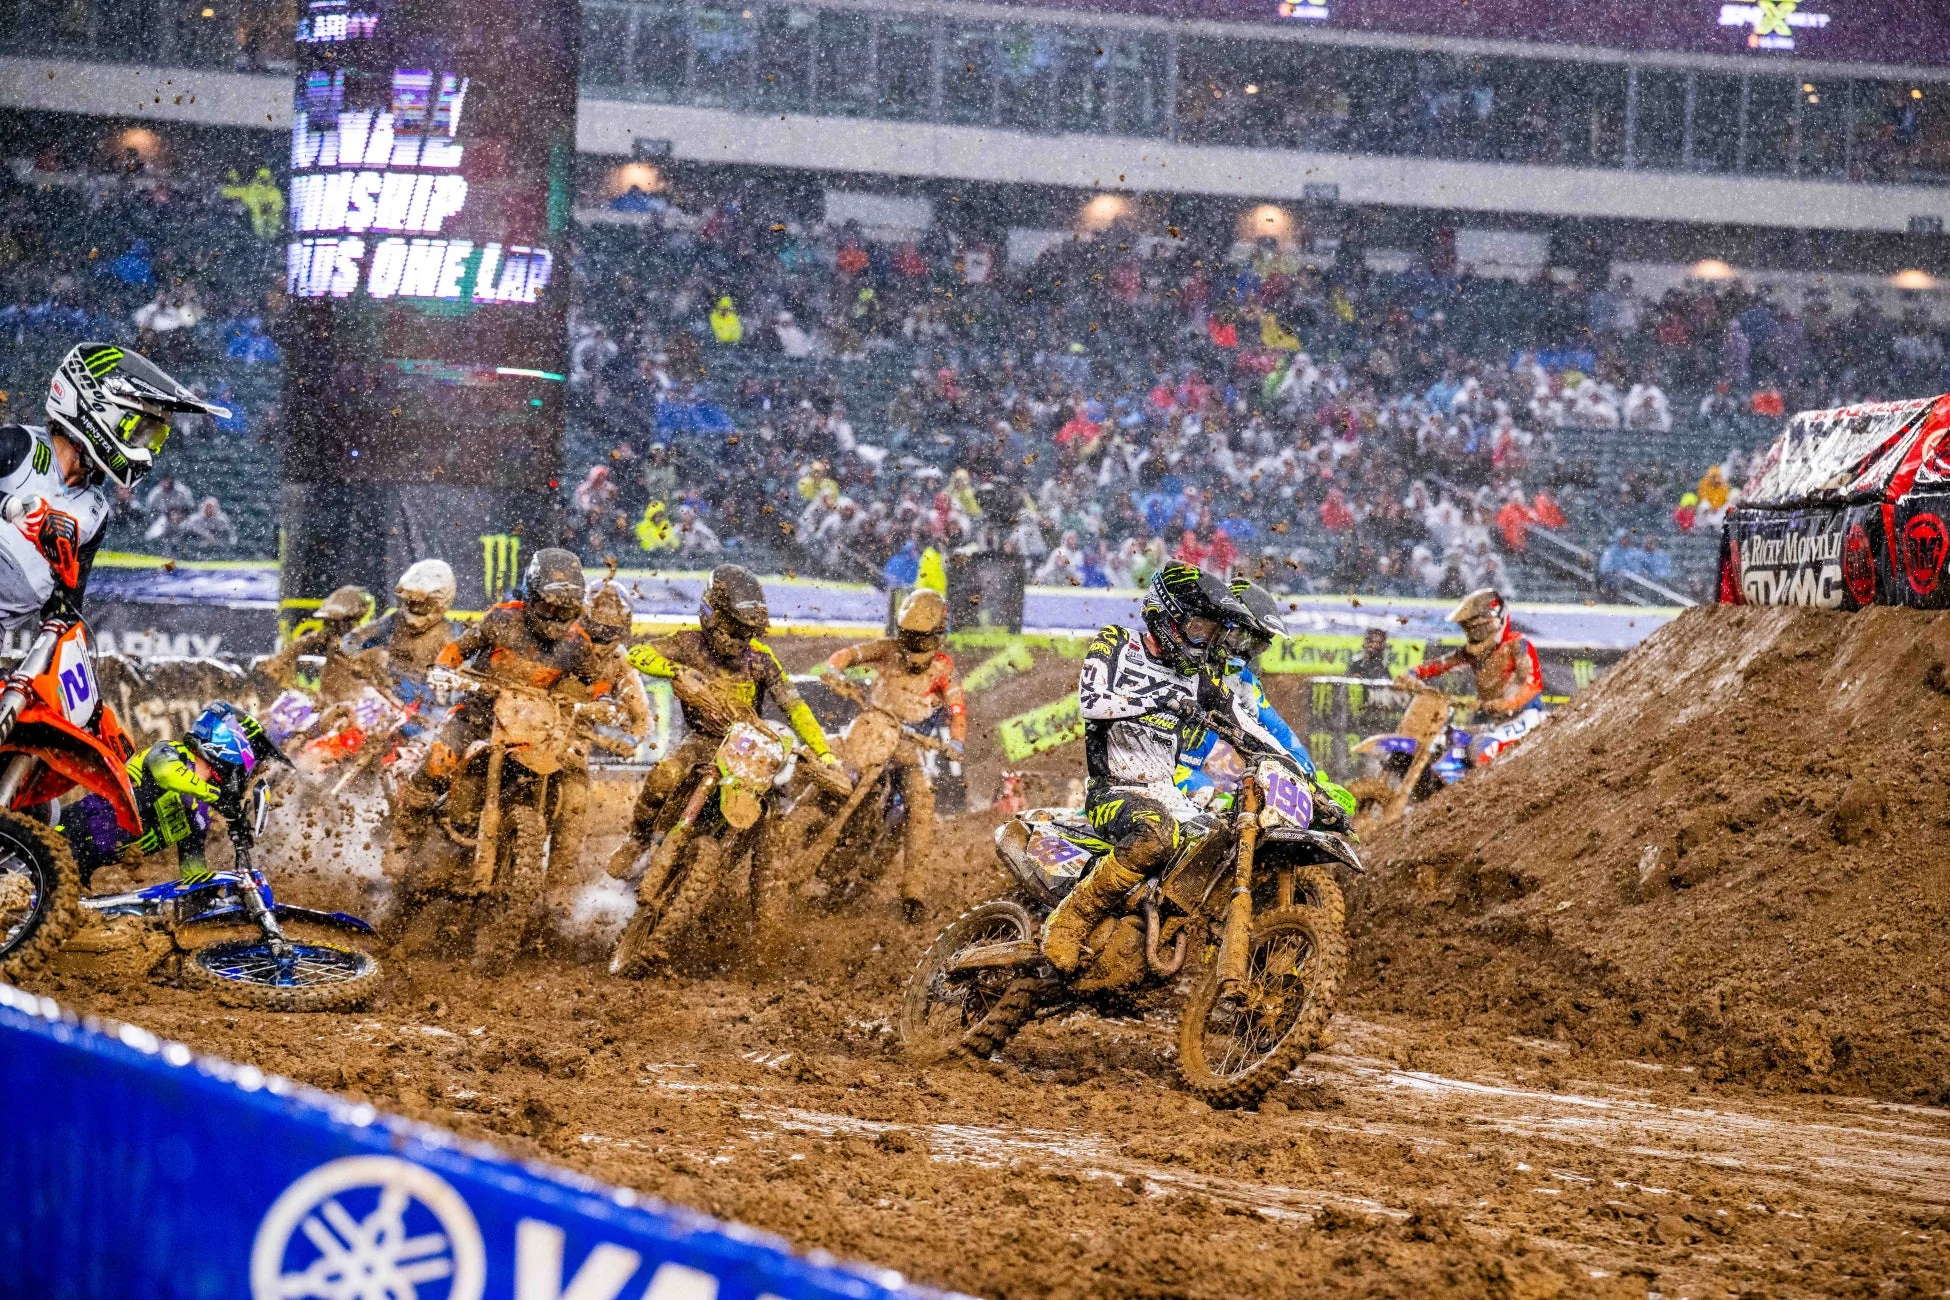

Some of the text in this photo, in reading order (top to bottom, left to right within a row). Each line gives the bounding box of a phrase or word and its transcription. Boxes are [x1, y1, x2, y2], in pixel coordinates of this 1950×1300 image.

[1281, 642, 1410, 669] Kawaki
[60, 662, 91, 712] 2
[1139, 715, 1176, 730] ACING
[1503, 719, 1526, 737] FLY
[1265, 772, 1312, 830] 199
